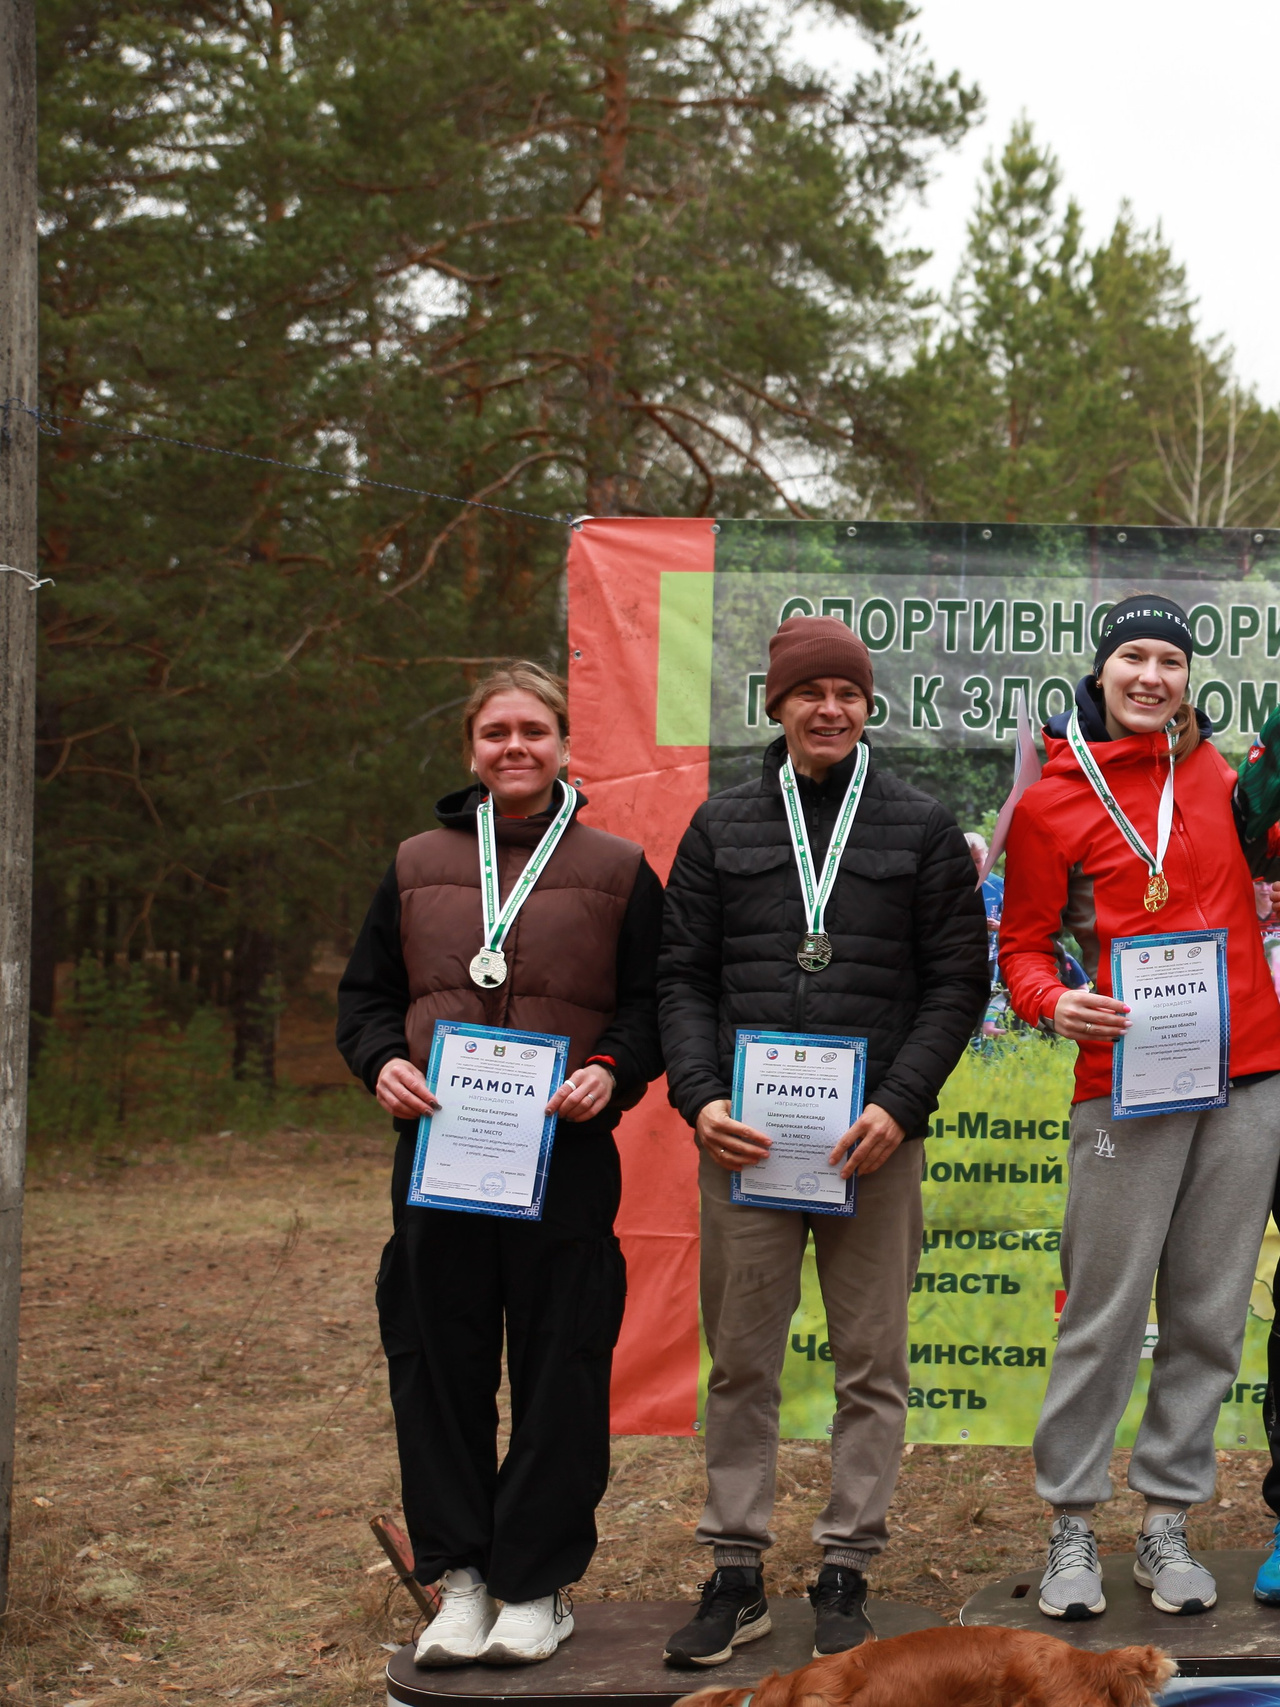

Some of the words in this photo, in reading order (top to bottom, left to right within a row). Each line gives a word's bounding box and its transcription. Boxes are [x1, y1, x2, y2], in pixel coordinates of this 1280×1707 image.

[911, 674, 944, 729] К
[1135, 981, 1206, 999] ГРАМОТА
[1153, 999, 1191, 1008] награждается
[450, 1075, 536, 1097] ГРАМОТА
[756, 1082, 839, 1100] ГРАМОТА
[469, 1094, 514, 1105] награждается
[775, 1100, 819, 1108] награждается
[489, 1109, 518, 1117] Екатерина
